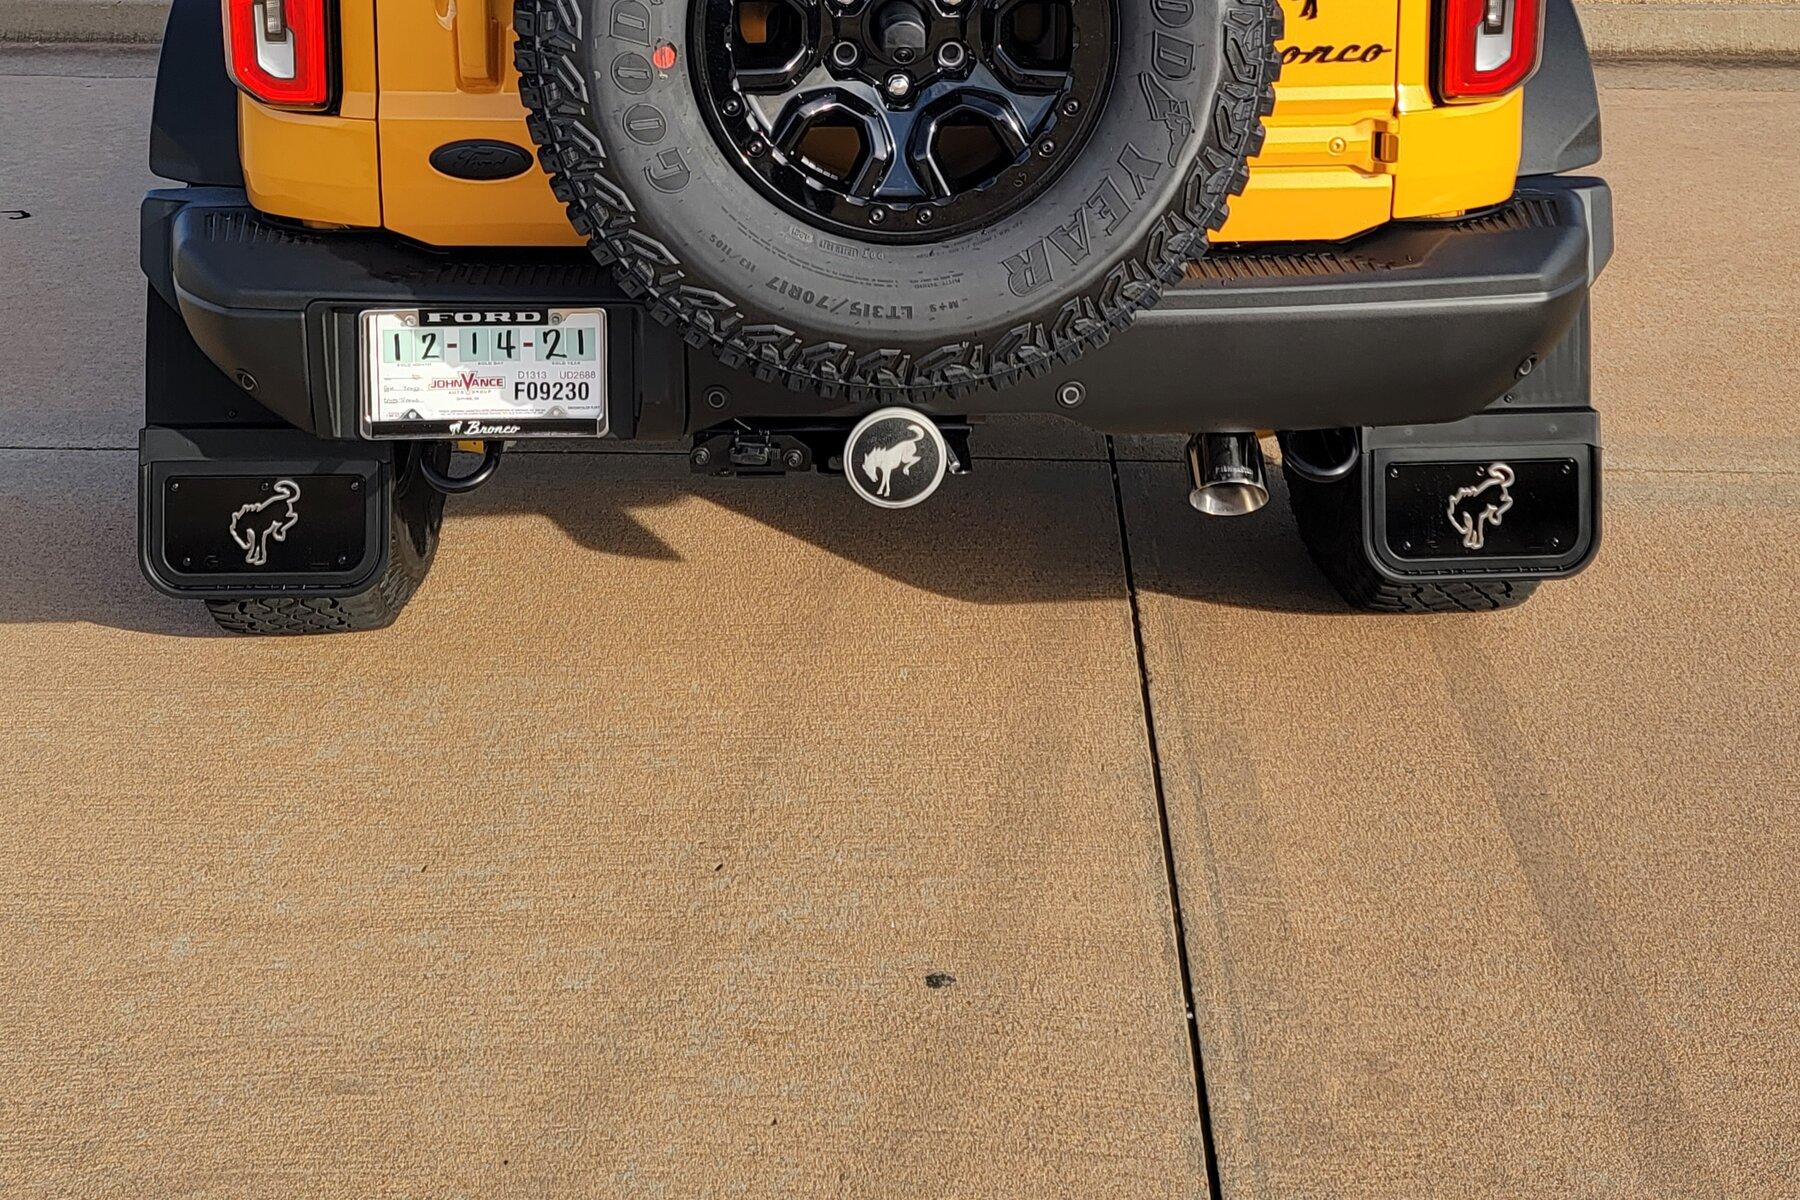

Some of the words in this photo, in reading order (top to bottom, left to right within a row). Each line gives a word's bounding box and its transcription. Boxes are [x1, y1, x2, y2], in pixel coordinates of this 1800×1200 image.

[1281, 43, 1392, 65] onco
[765, 276, 913, 320] LT315/70R17
[427, 312, 541, 323] FORD
[517, 370, 547, 380] D1313
[559, 370, 596, 380] UD2688
[514, 381, 590, 401] F09230
[463, 420, 520, 435] Bronco
